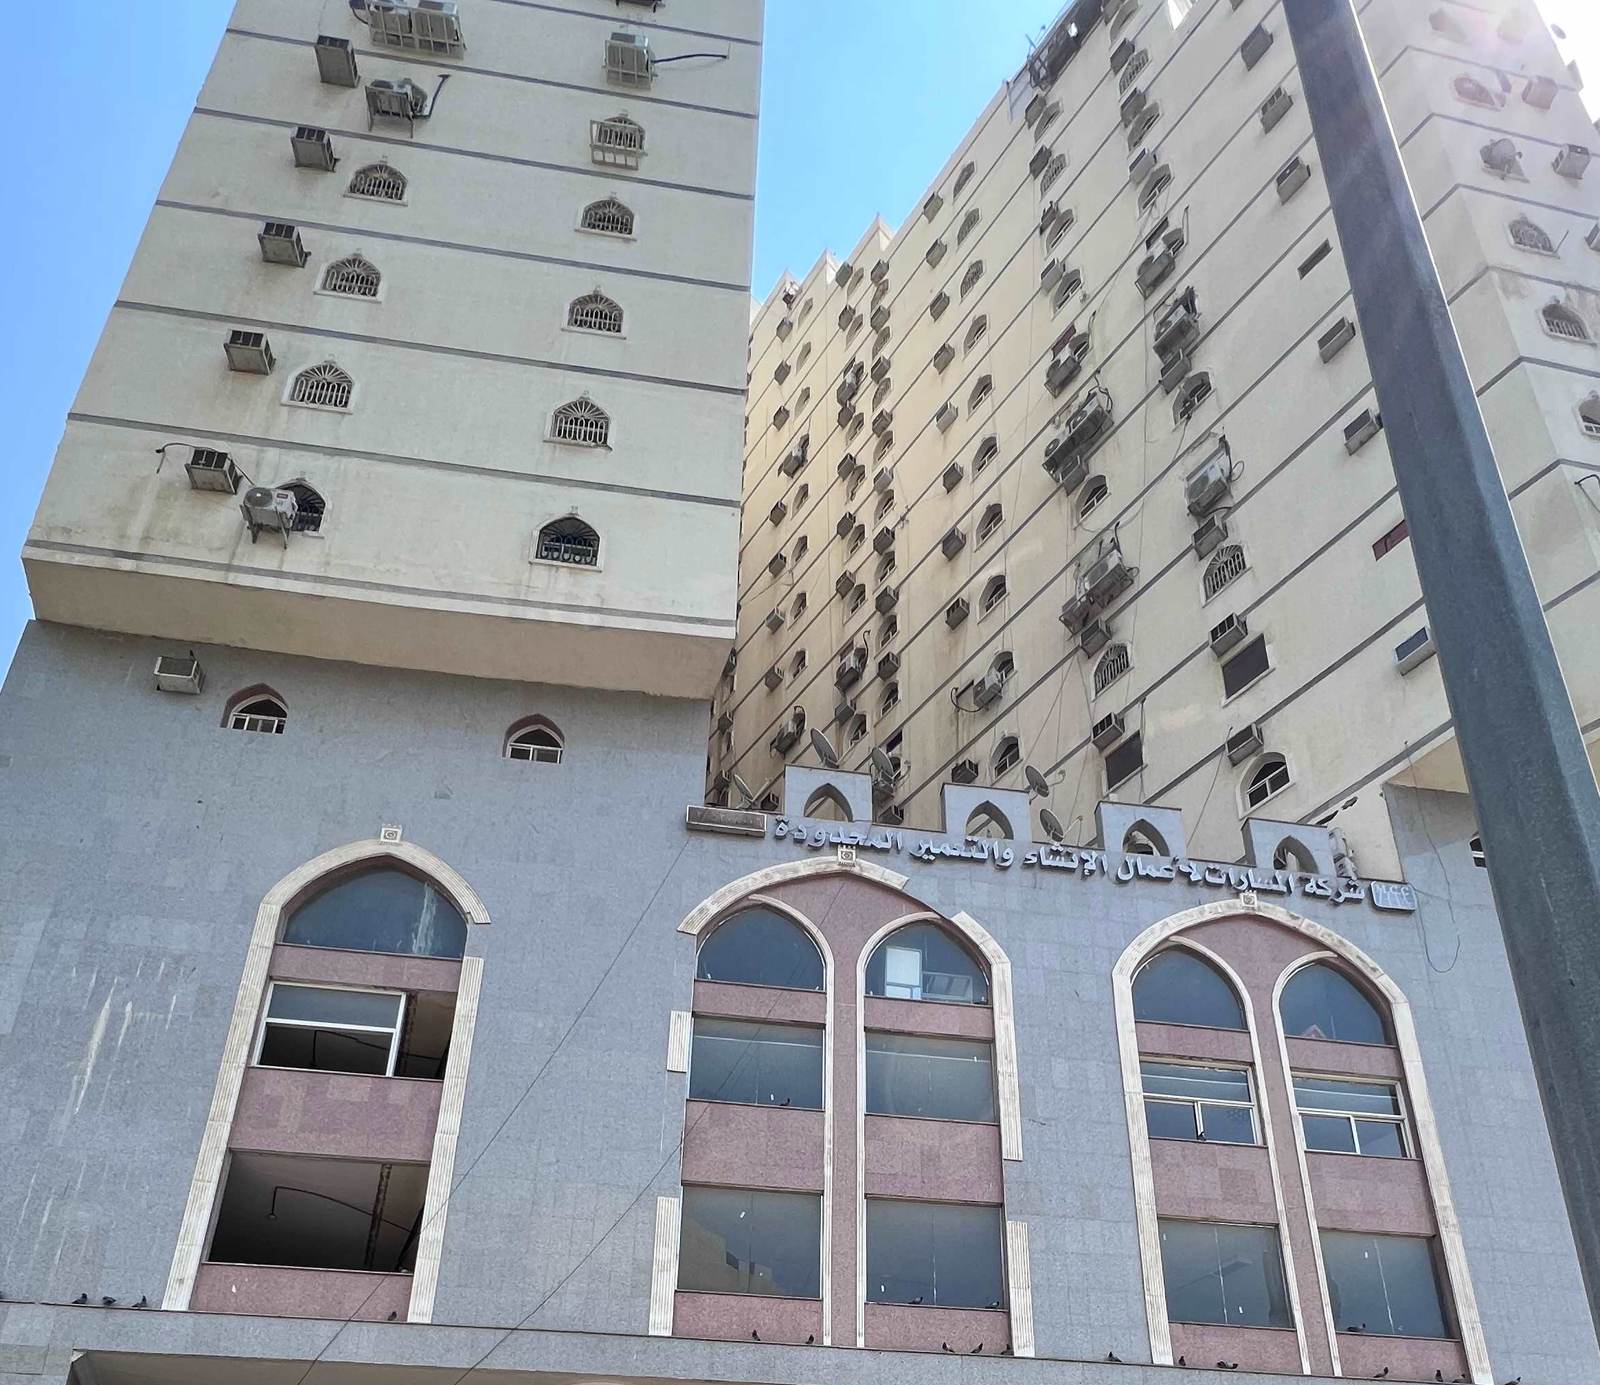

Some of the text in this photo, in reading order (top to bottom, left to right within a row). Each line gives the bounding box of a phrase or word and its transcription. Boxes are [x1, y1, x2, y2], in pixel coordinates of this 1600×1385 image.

[775, 815, 902, 850] المحدودة
[909, 836, 1014, 867] والتعمير
[1023, 841, 1108, 876] الإنشاء
[1205, 863, 1295, 895] المسارات
[1302, 877, 1366, 903] شركة
